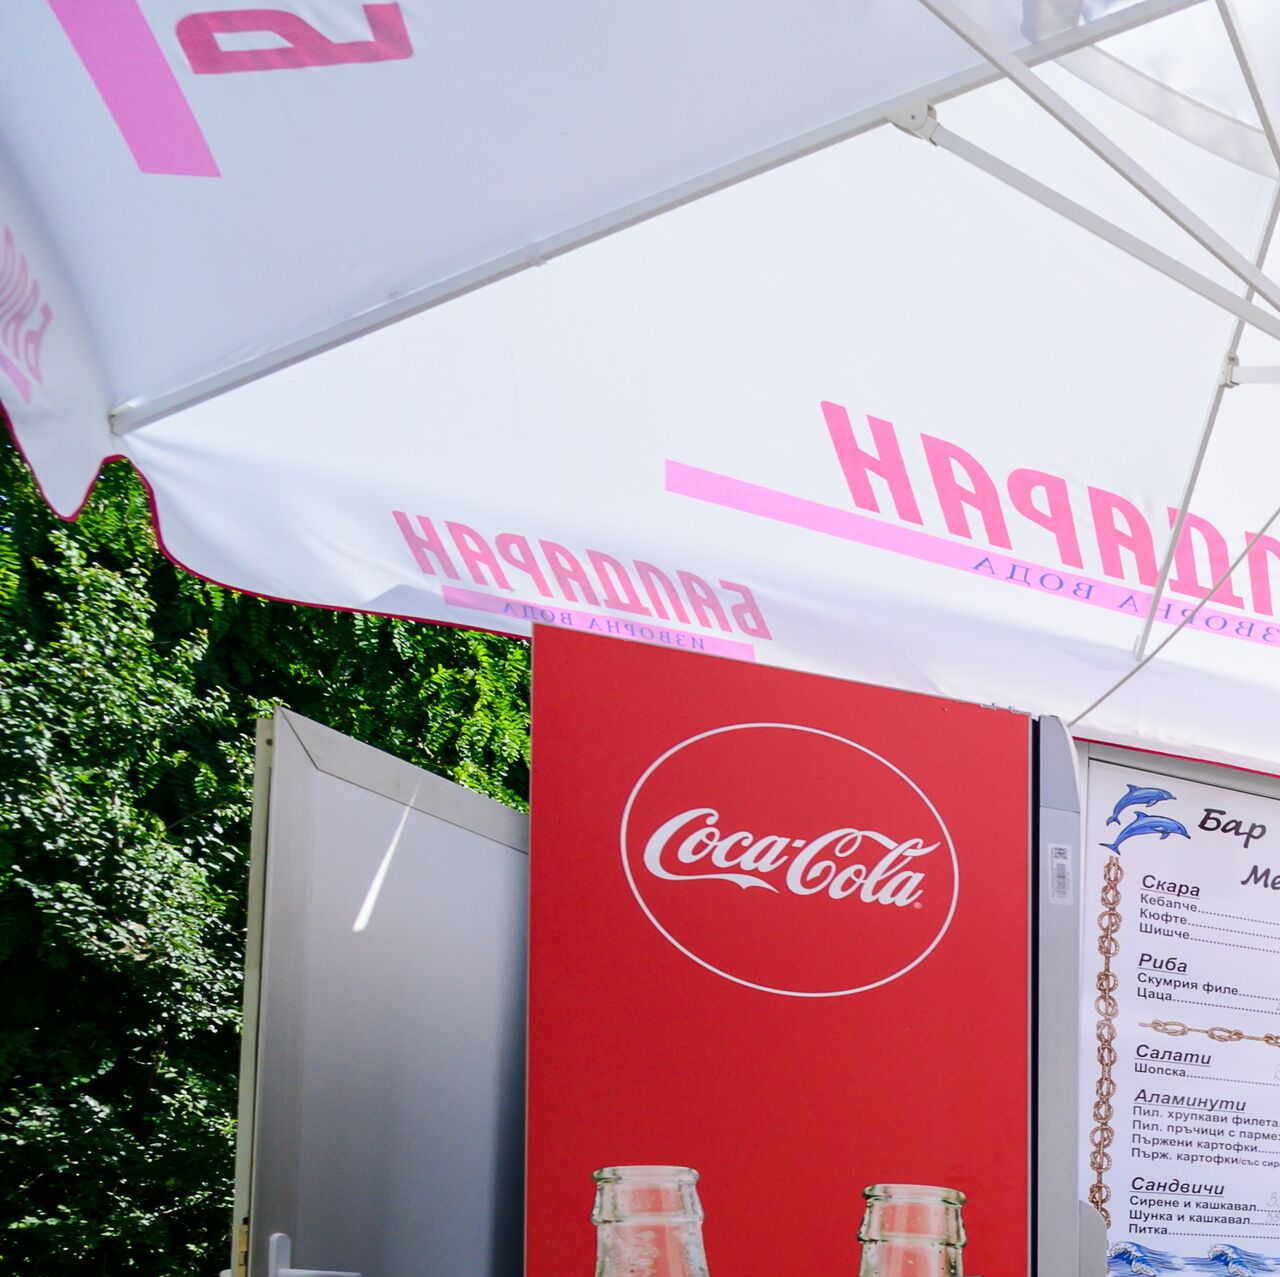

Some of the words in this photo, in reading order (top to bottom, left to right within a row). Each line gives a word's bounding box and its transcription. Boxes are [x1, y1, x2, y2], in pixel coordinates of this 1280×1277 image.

[1197, 808, 1267, 848] Бар
[643, 807, 942, 909] Coca-Cola
[1141, 874, 1201, 897] Скара
[1140, 892, 1198, 912] Кебапче
[1139, 907, 1187, 926] Кюфте
[1139, 922, 1190, 940] Шишче
[1138, 953, 1188, 974] Риба
[1137, 972, 1198, 991] Скумрия
[1202, 982, 1239, 997] филе
[1137, 987, 1173, 1003] Цаца
[1136, 1044, 1212, 1065] Салати
[1134, 1062, 1185, 1077] Шопска
[1134, 1088, 1247, 1112] Аламинути
[1132, 1106, 1163, 1118] Пил.
[1167, 1109, 1228, 1127] хрупкави
[1231, 1114, 1279, 1130] филета
[1132, 1120, 1163, 1132] Пил.
[1166, 1125, 1224, 1140] пръчици
[1131, 1134, 1193, 1149] Пържени
[1197, 1141, 1259, 1157] картофки
[1131, 1147, 1172, 1162] Пърж.
[1131, 1176, 1225, 1195] Сандвичи
[1129, 1195, 1180, 1210] Сирене
[1184, 1200, 1191, 1208] и
[1195, 1200, 1257, 1212] кашкавал
[1129, 1209, 1173, 1224] Шунка
[1177, 1214, 1185, 1222] и
[1189, 1214, 1251, 1226] кашкавал
[1128, 1223, 1169, 1236] Питка
